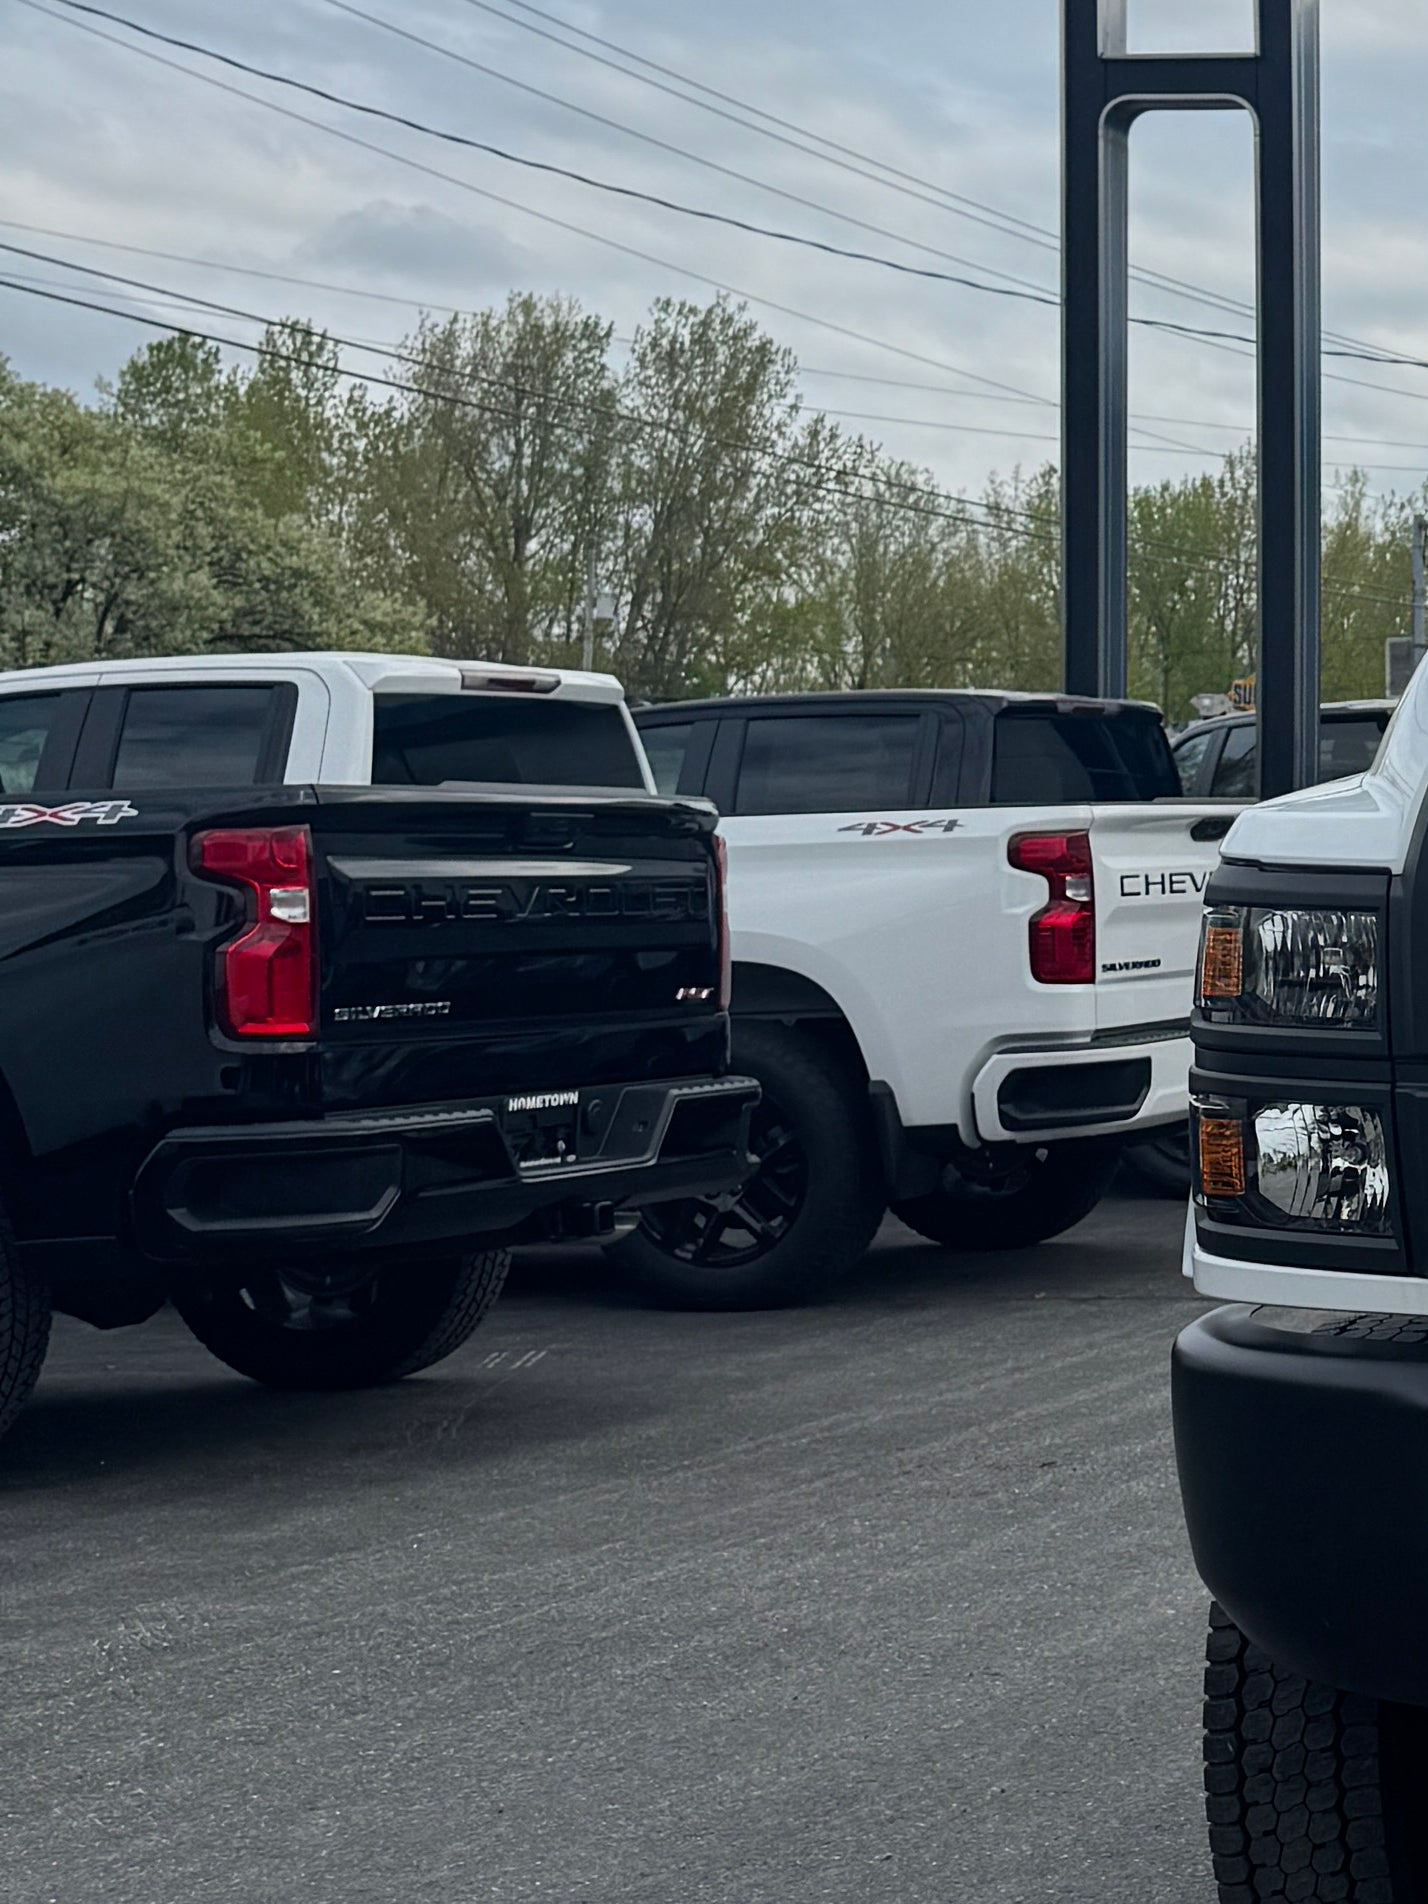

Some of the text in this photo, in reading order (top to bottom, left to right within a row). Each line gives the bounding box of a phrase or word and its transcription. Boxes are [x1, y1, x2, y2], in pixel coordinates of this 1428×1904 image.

[1120, 871, 1210, 897] CHEV
[1101, 959, 1161, 973] SILVERADO
[334, 1001, 451, 1021] SILVERADO
[508, 1091, 579, 1112] HOMETOWN
